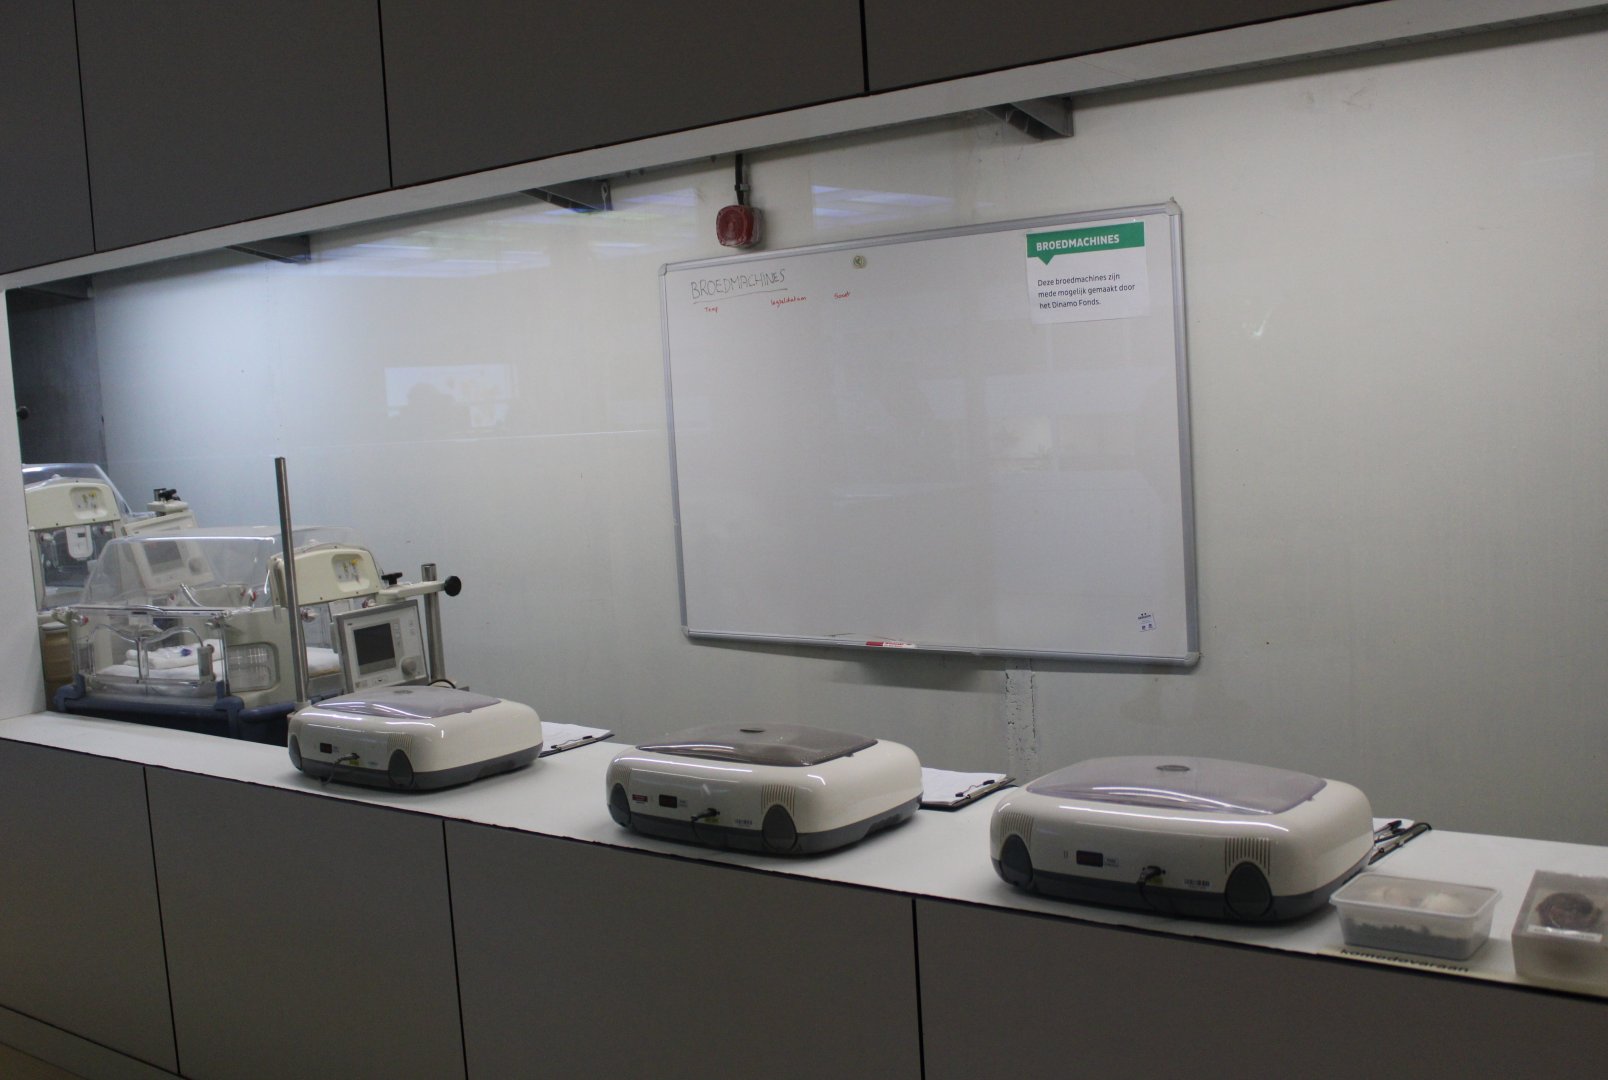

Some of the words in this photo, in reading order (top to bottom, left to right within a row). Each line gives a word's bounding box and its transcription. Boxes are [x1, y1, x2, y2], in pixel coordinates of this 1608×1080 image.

[1036, 234, 1120, 251] BROEDMACHINES
[690, 268, 786, 300] BROEDMACHINES
[1037, 279, 1054, 287] Deze
[1056, 275, 1107, 285] broedmachines
[1108, 273, 1120, 282] zijn
[1038, 288, 1057, 298] mede
[1057, 287, 1087, 298] mogelijk
[1088, 285, 1118, 295] gemaakt
[1118, 283, 1136, 292] door
[1039, 301, 1051, 309] het
[1052, 300, 1078, 309] Dinamo
[1079, 298, 1101, 306] Fonds.
